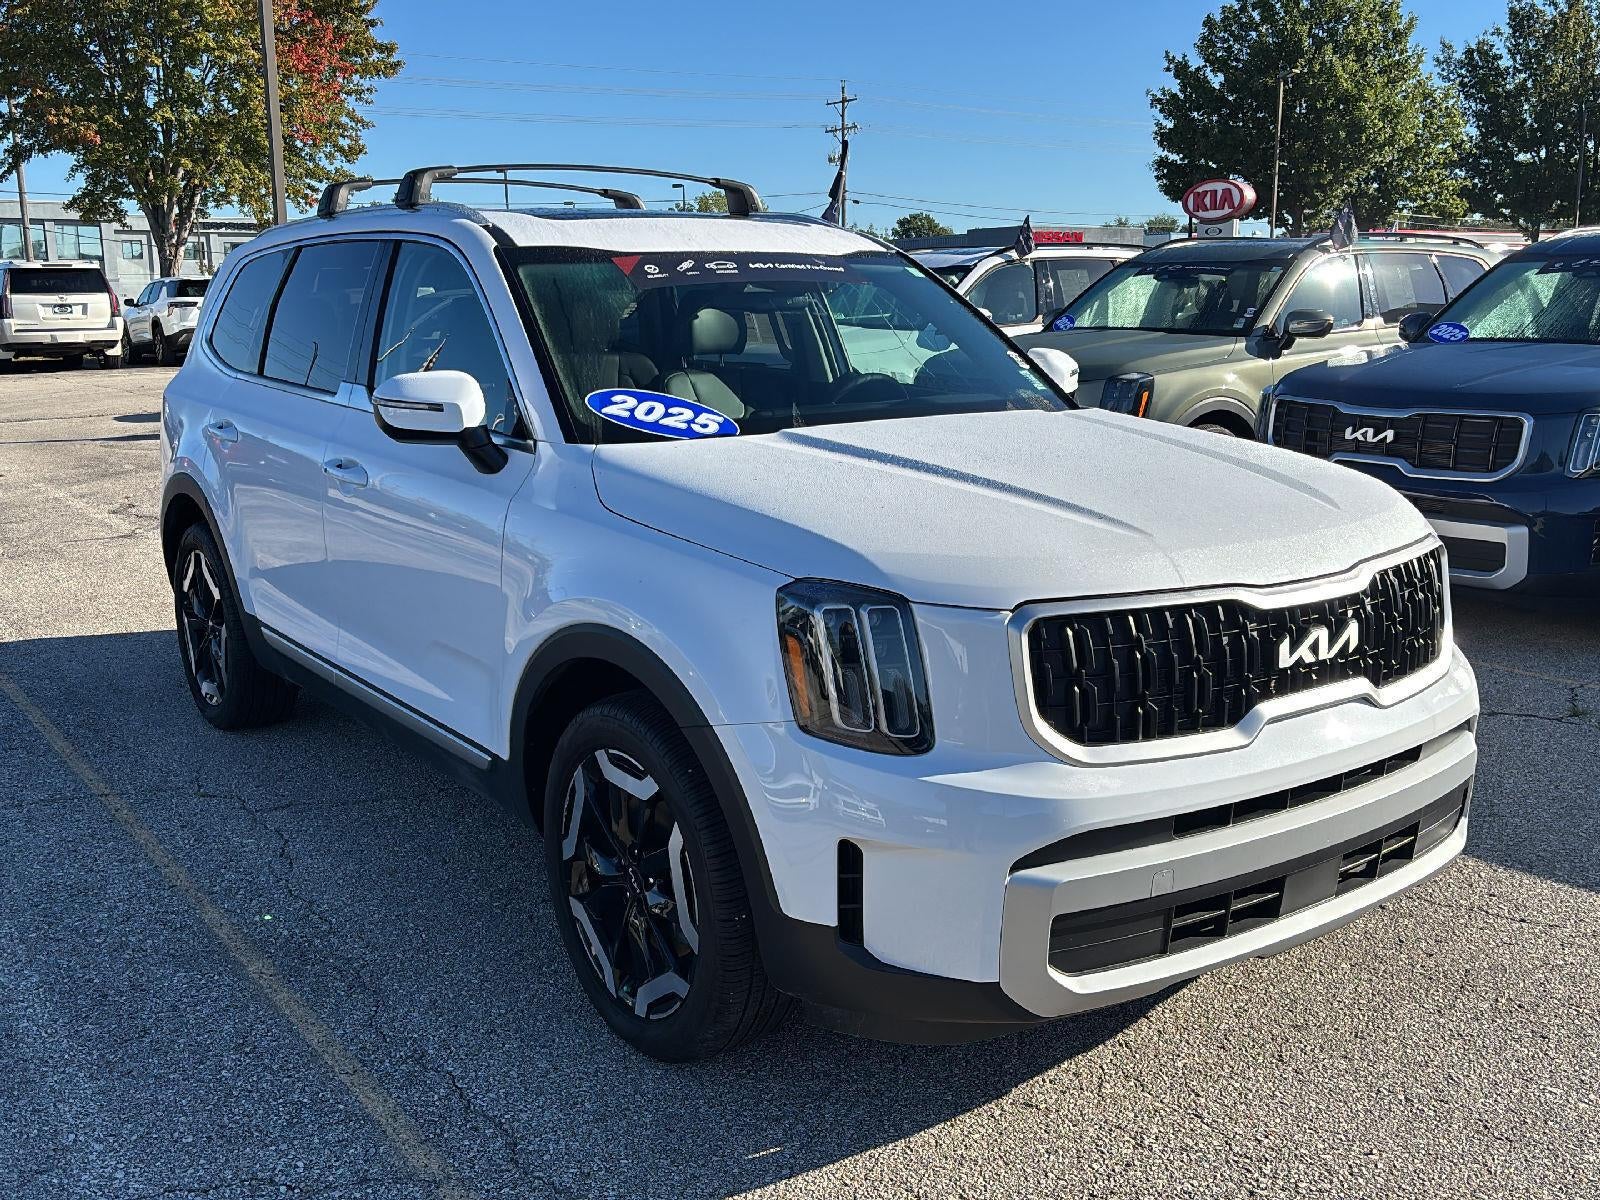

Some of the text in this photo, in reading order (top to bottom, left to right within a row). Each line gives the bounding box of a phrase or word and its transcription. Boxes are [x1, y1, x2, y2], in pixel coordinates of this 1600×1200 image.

[1193, 188, 1234, 212] KIA
[1430, 325, 1468, 340] 2025
[601, 394, 725, 435] 2025
